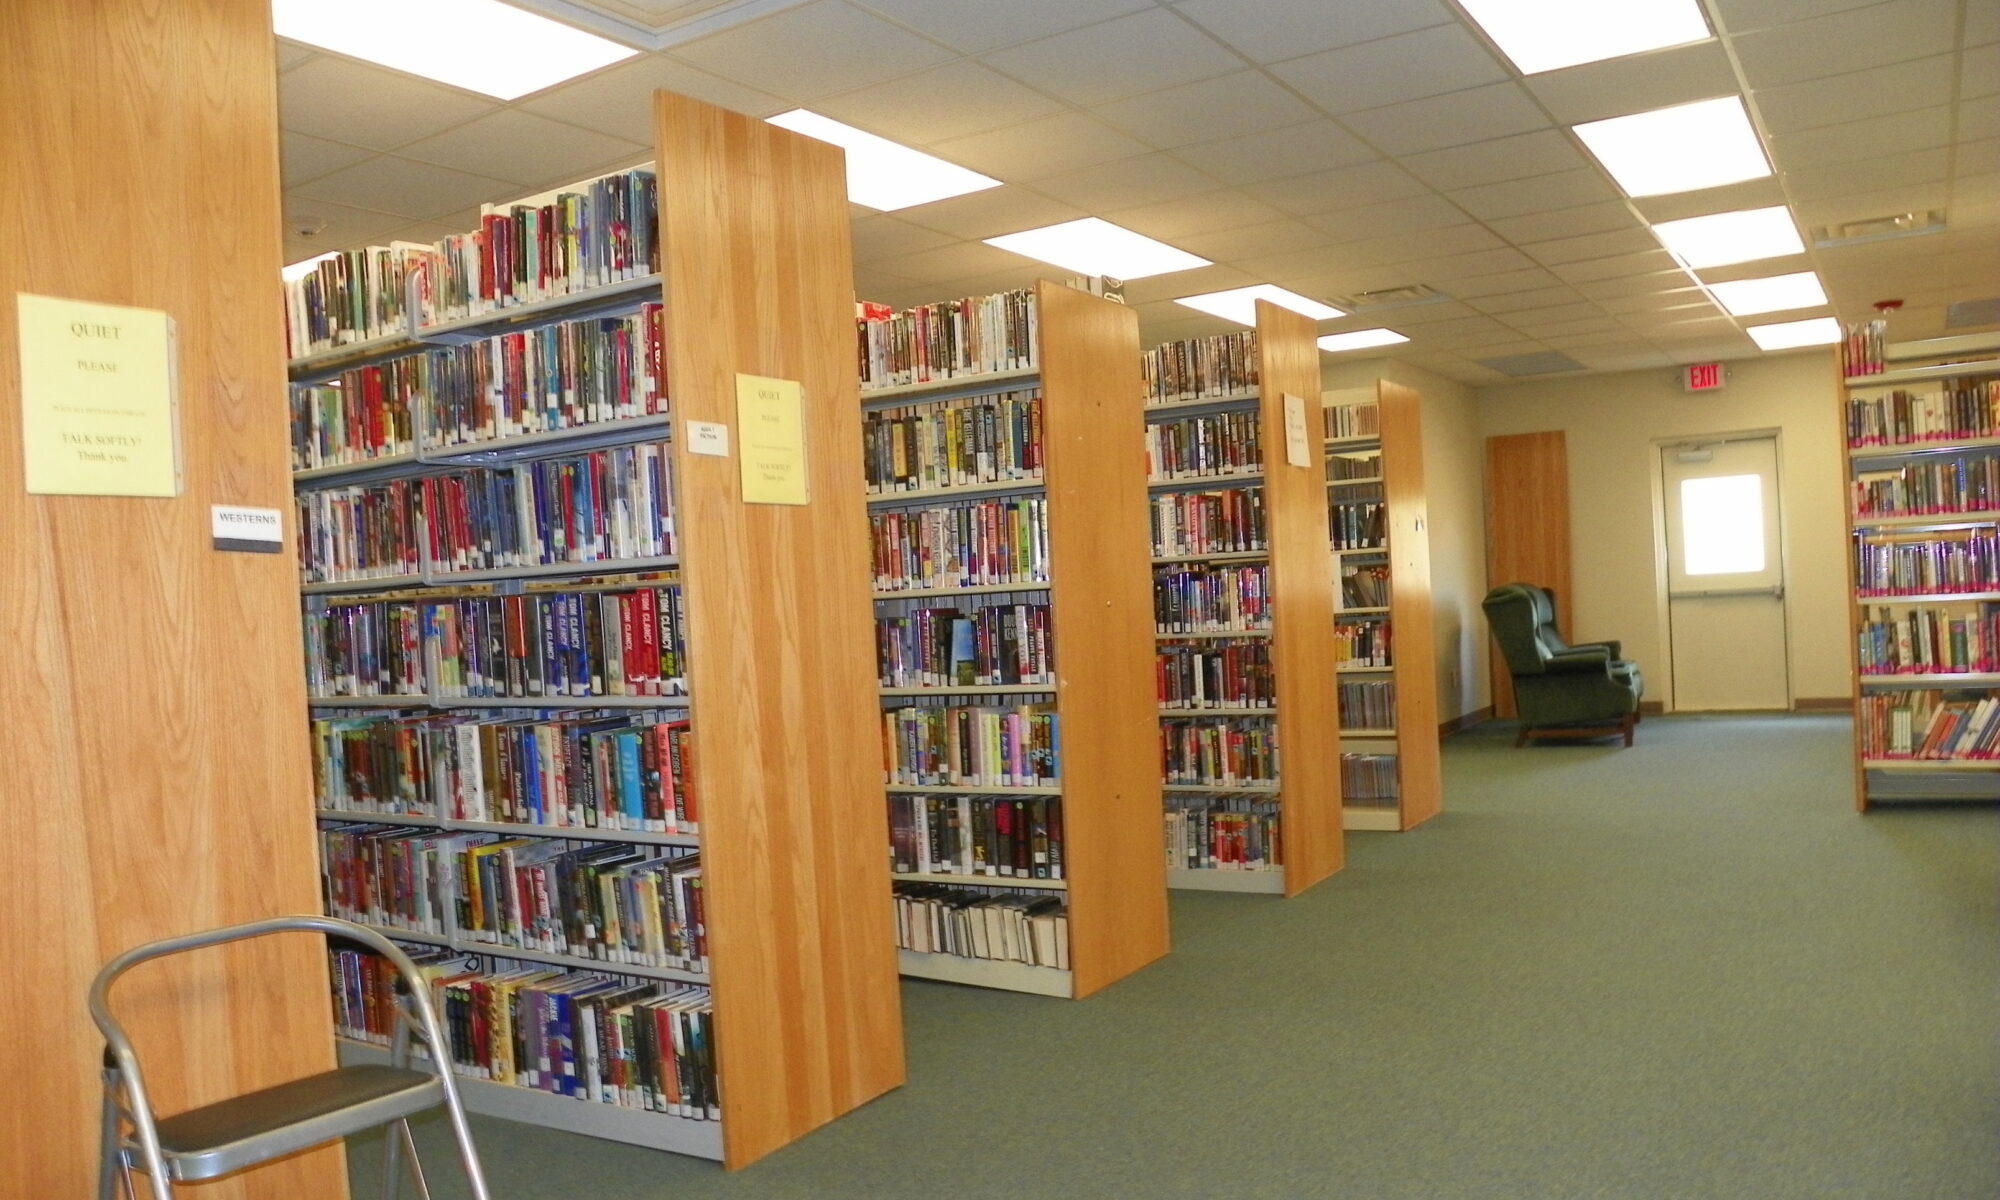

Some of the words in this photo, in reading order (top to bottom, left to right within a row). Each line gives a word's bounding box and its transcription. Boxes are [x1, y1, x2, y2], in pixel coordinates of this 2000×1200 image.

[71, 323, 122, 339] QUIET
[77, 360, 118, 373] PLEASE
[1690, 364, 1718, 388] EXIT
[61, 433, 92, 445] TALK
[77, 451, 107, 462] Thank
[109, 454, 128, 465] you
[219, 512, 277, 525] WESTERNS
[558, 601, 566, 617] TOM
[568, 597, 578, 616] TOM
[642, 592, 650, 611] TOM
[659, 592, 669, 613] TOM
[544, 614, 553, 631] TOM
[624, 607, 632, 622] TOM
[559, 618, 568, 646] CLANCY
[570, 617, 580, 649] CLANCY
[624, 623, 633, 651] CLANCY
[642, 612, 652, 645] CLANCY
[661, 615, 672, 651] CLANCY
[546, 631, 555, 661] CLANCY
[671, 753, 680, 775] COBEN
